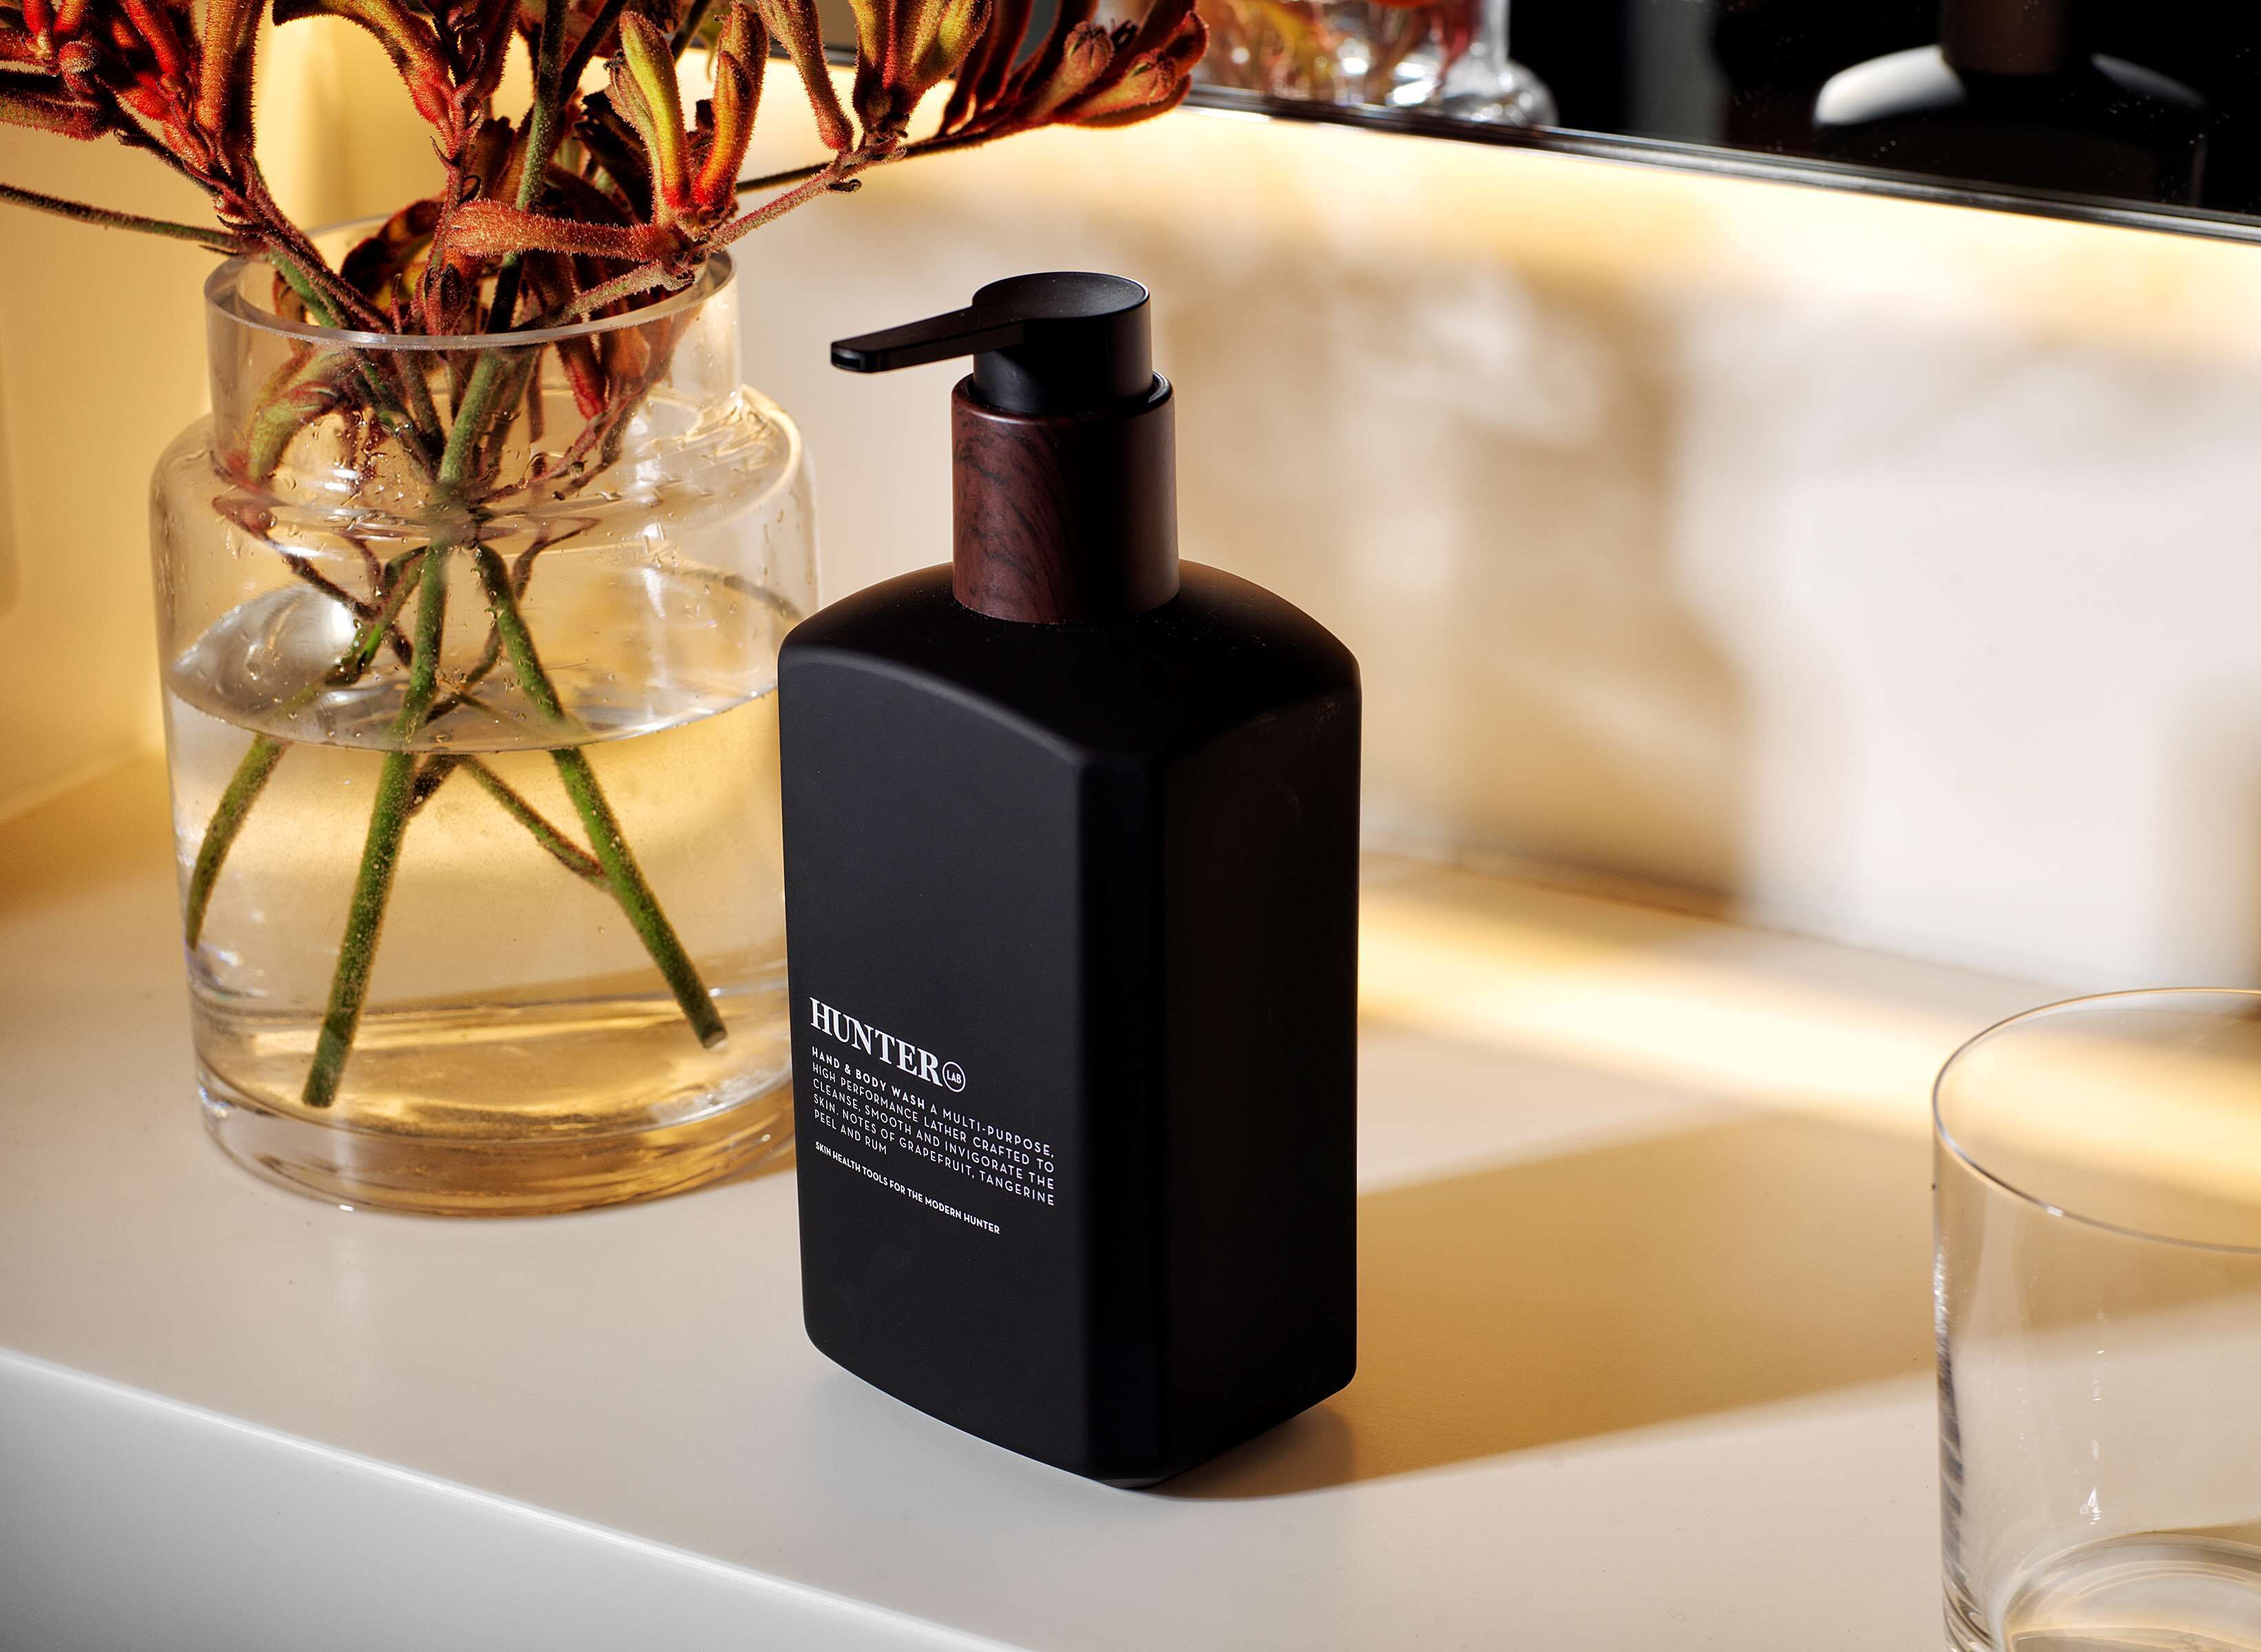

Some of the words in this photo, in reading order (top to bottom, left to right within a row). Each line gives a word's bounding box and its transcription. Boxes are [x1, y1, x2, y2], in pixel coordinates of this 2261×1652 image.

[810, 997, 943, 1088] HUNTER
[812, 1046, 840, 1069] HAND
[845, 1063, 851, 1074] &
[856, 1068, 887, 1092] BODY
[891, 1085, 925, 1110] WASH
[930, 1104, 937, 1114] A
[943, 1108, 1055, 1158] MULTI-PURPOSE,
[812, 1062, 836, 1083] HIGH
[841, 1077, 918, 1123] PERFORMANCE
[924, 1116, 967, 1143] LATHER
[973, 1137, 1029, 1165] CRAFTED
[1037, 1158, 1054, 1173] TO
[813, 1078, 861, 1112] CLEANSE,
[865, 1105, 912, 1135] SMOOTH
[916, 1130, 940, 1147] AND
[945, 1141, 1022, 1179] INVIGORATE
[1029, 1172, 1054, 1190] THE
[814, 1109, 837, 1130] PEEL
[840, 1125, 861, 1141] AND
[865, 1137, 887, 1155] RUM
[814, 1094, 839, 1116] SKIN.
[843, 1110, 876, 1134] NOTES
[881, 1128, 895, 1142] OF
[899, 1138, 975, 1179] GRAPEFRUIT,
[979, 1170, 1055, 1206] TANGERINE
[815, 1141, 832, 1157] SKIN
[832, 1152, 861, 1173] HEALTH
[862, 1166, 888, 1187] TOOLS
[890, 1180, 905, 1195] FOR
[907, 1188, 923, 1203] THE
[925, 1196, 962, 1220] MODERN
[963, 1213, 1000, 1235] HUNTER
